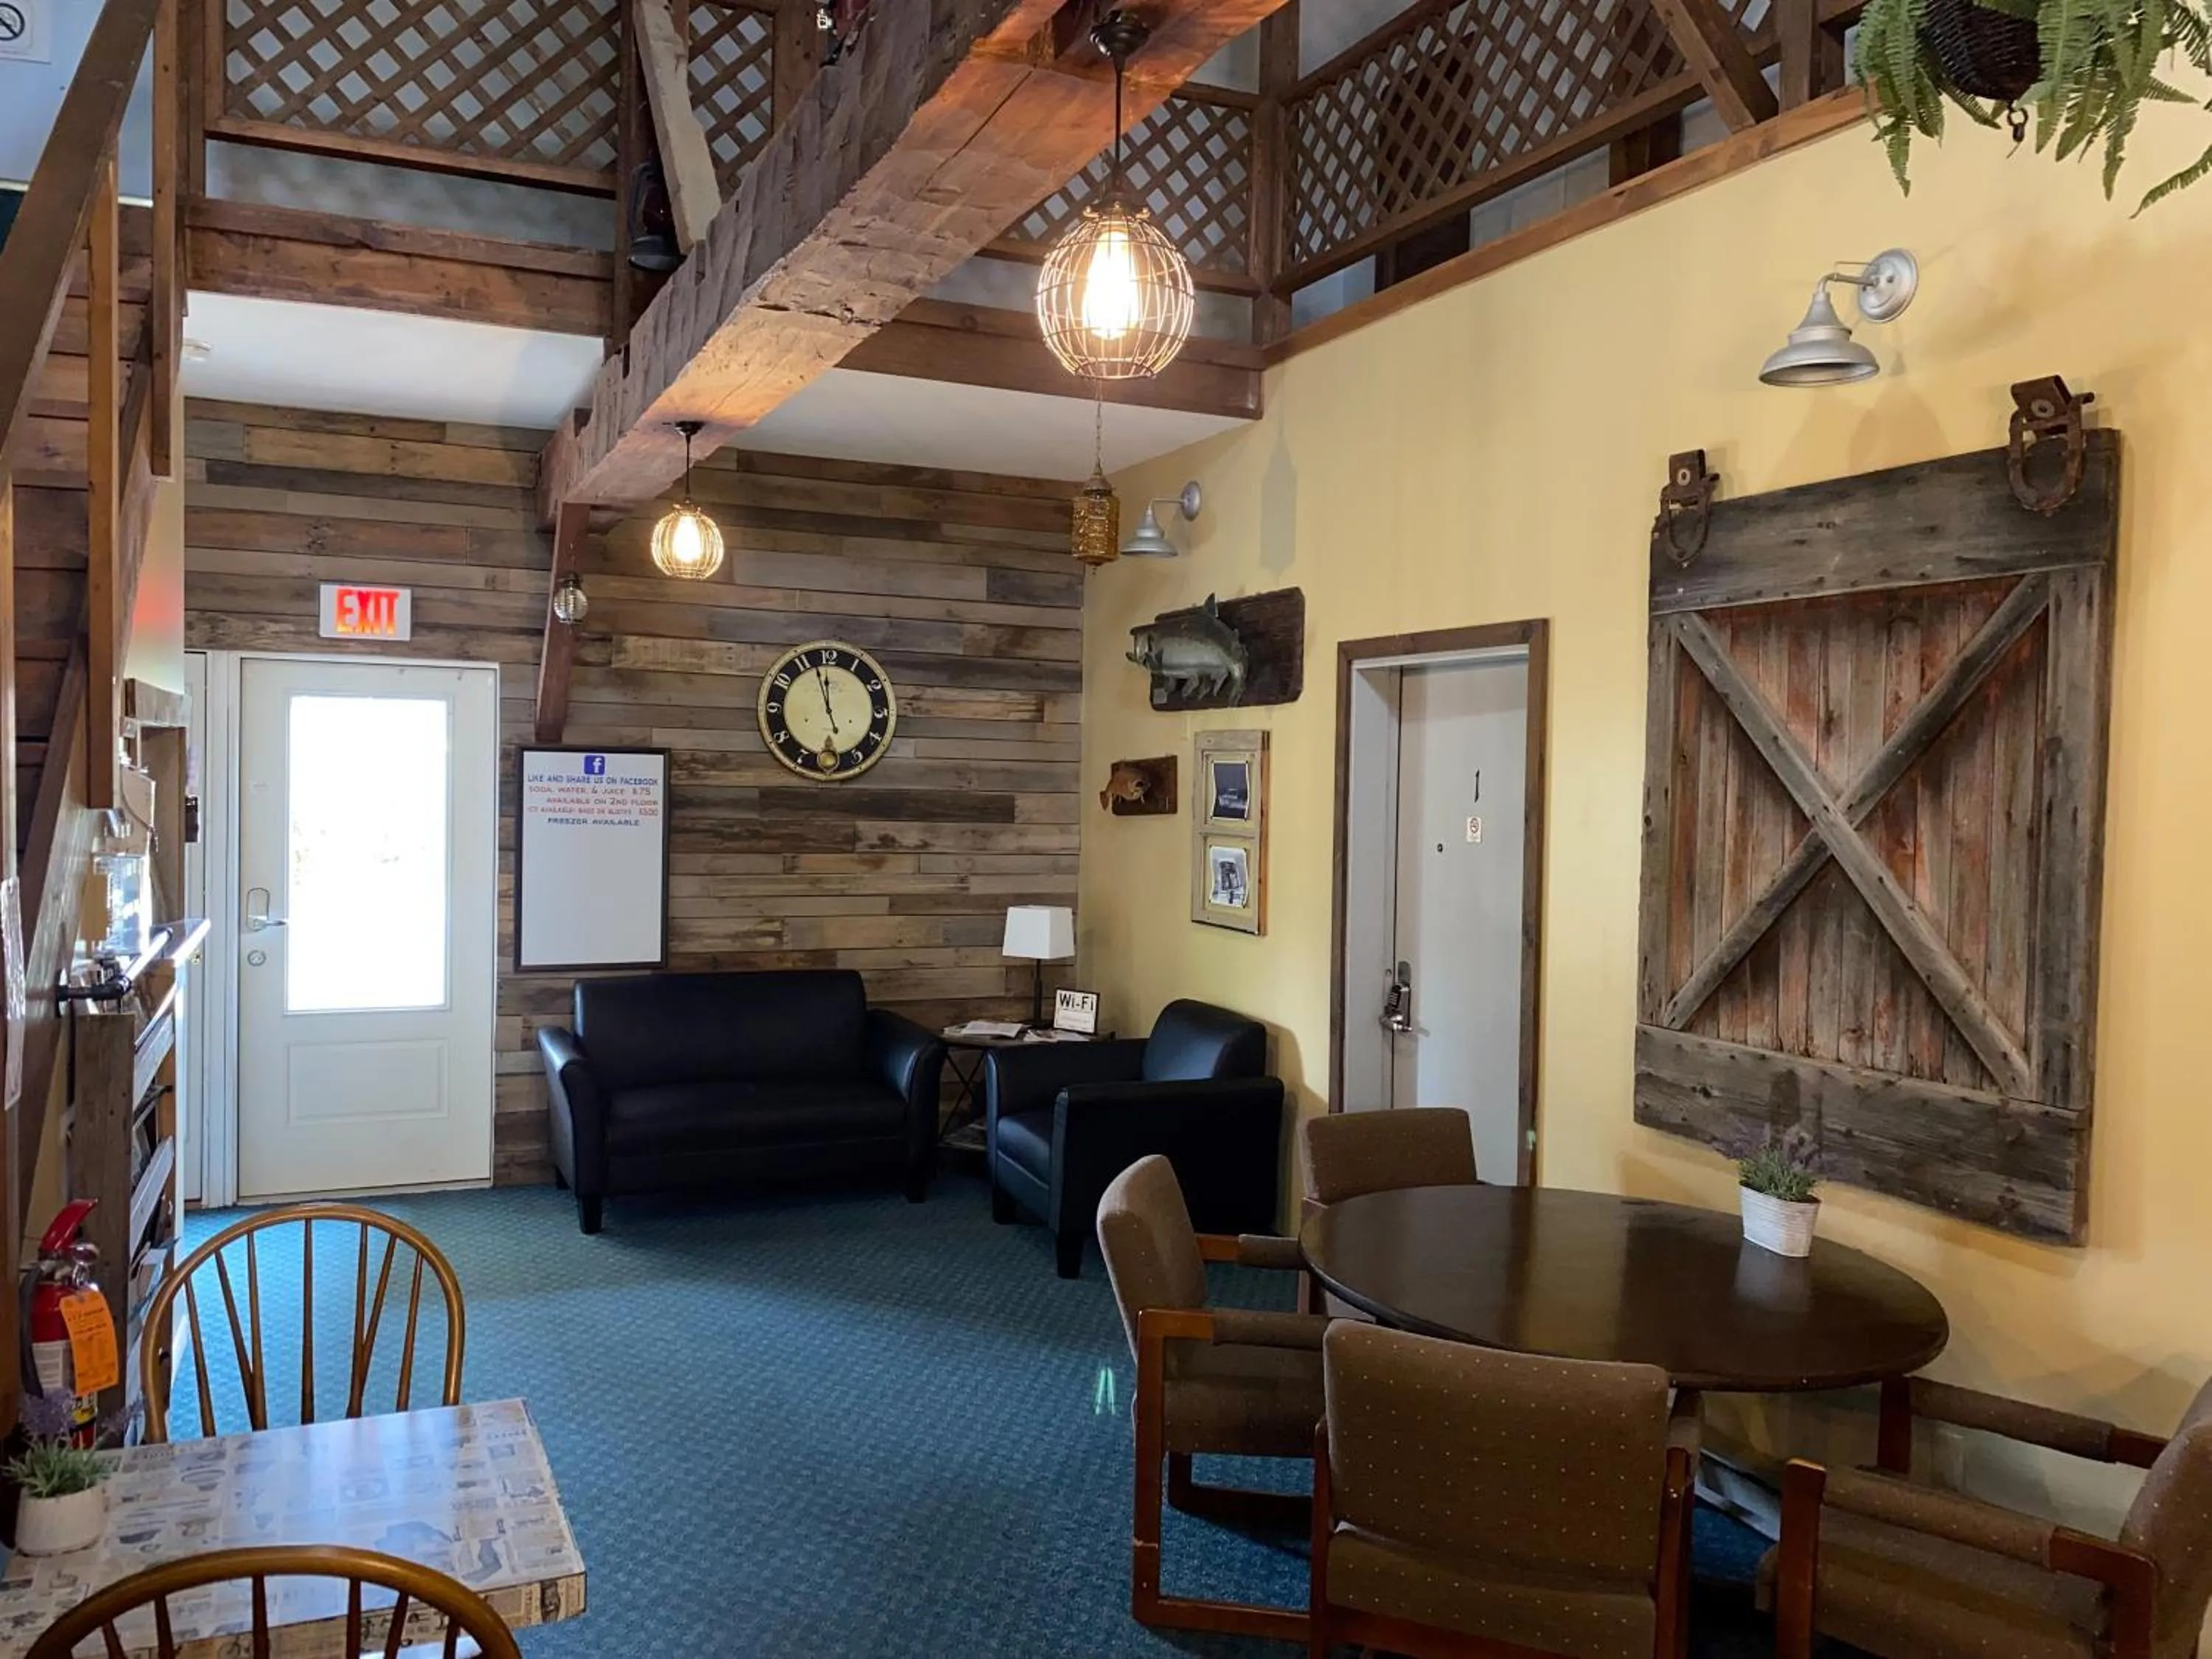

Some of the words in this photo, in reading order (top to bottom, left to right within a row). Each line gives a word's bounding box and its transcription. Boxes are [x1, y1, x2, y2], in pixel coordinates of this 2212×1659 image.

[336, 588, 400, 634] EXIT
[794, 654, 811, 672] 11
[820, 650, 838, 665] 12
[850, 659, 859, 672] 1
[775, 673, 791, 689] 10
[867, 679, 882, 692] 2
[767, 702, 782, 714] 9
[873, 706, 888, 719] 3
[774, 731, 790, 744] 8
[869, 731, 882, 746] 4
[797, 748, 810, 765] 7
[851, 749, 863, 765] 5
[528, 774, 543, 782] LIKE
[547, 774, 564, 783] AND
[566, 775, 591, 784] SHARE
[594, 776, 604, 785] US
[606, 776, 617, 785] ON
[620, 776, 658, 786] FACEBOOK
[591, 785, 598, 794] &
[609, 797, 627, 806] 2ND
[631, 799, 658, 807] FLOOR
[548, 816, 588, 825] FREEZER
[592, 818, 641, 827] AVAILABLE
[1060, 992, 1093, 1011] Wi-Fi
